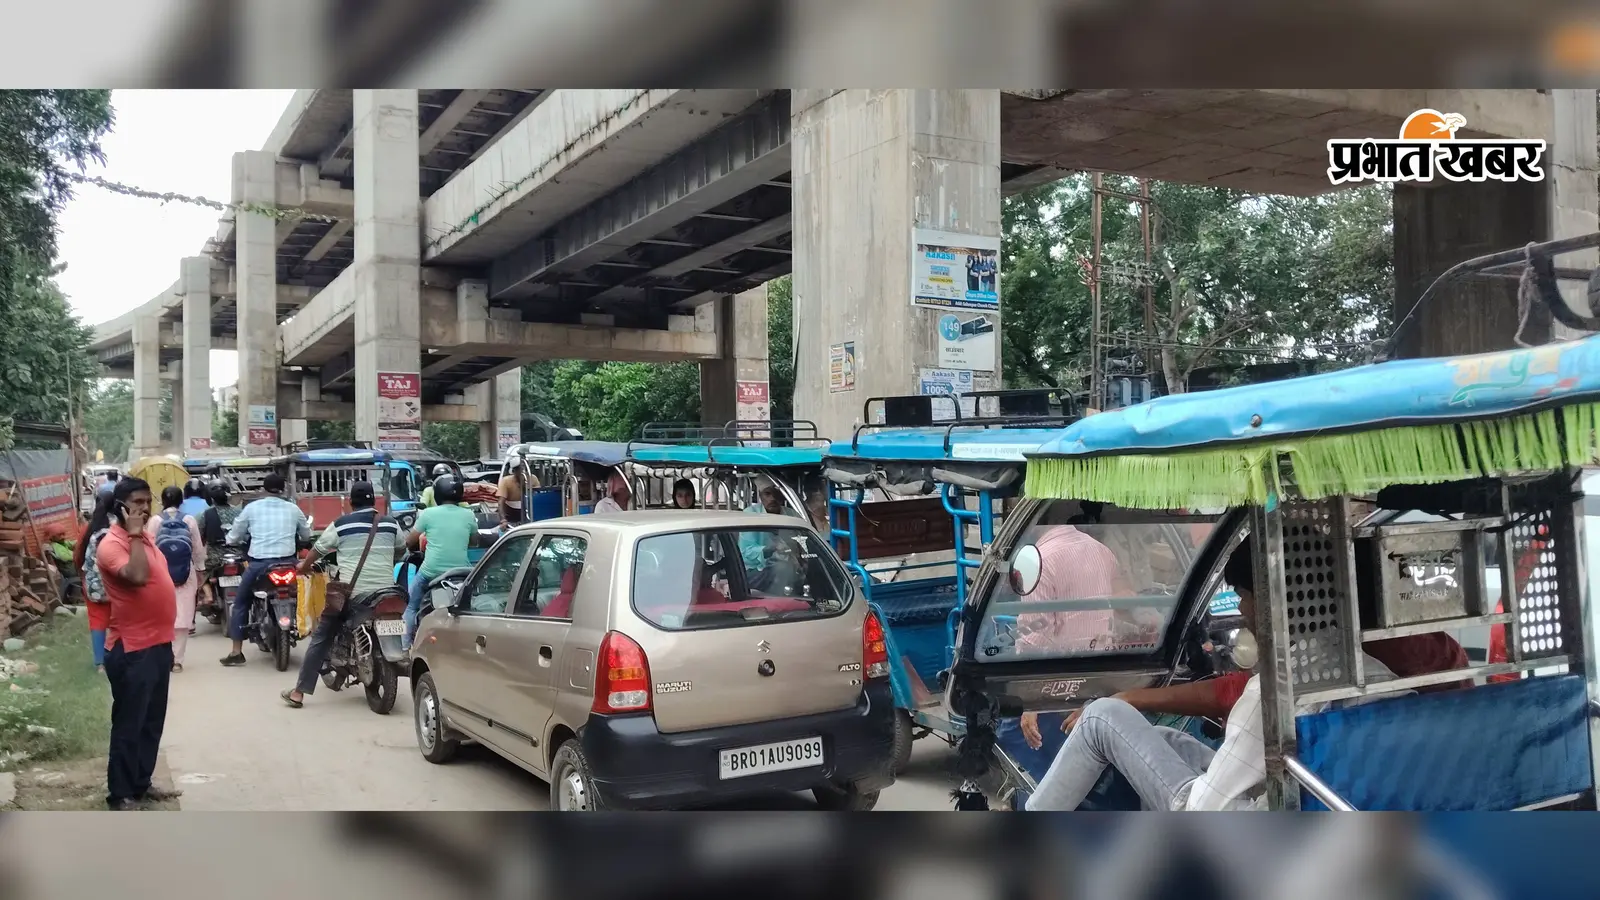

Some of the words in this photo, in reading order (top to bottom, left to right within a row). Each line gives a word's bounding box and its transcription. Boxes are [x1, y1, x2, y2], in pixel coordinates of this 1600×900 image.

[385, 380, 411, 389] TAJ
[743, 387, 762, 396] TAJ
[839, 663, 861, 672] ALTO
[656, 686, 692, 694] SUZUKI
[730, 741, 821, 771] BR01AU9099
